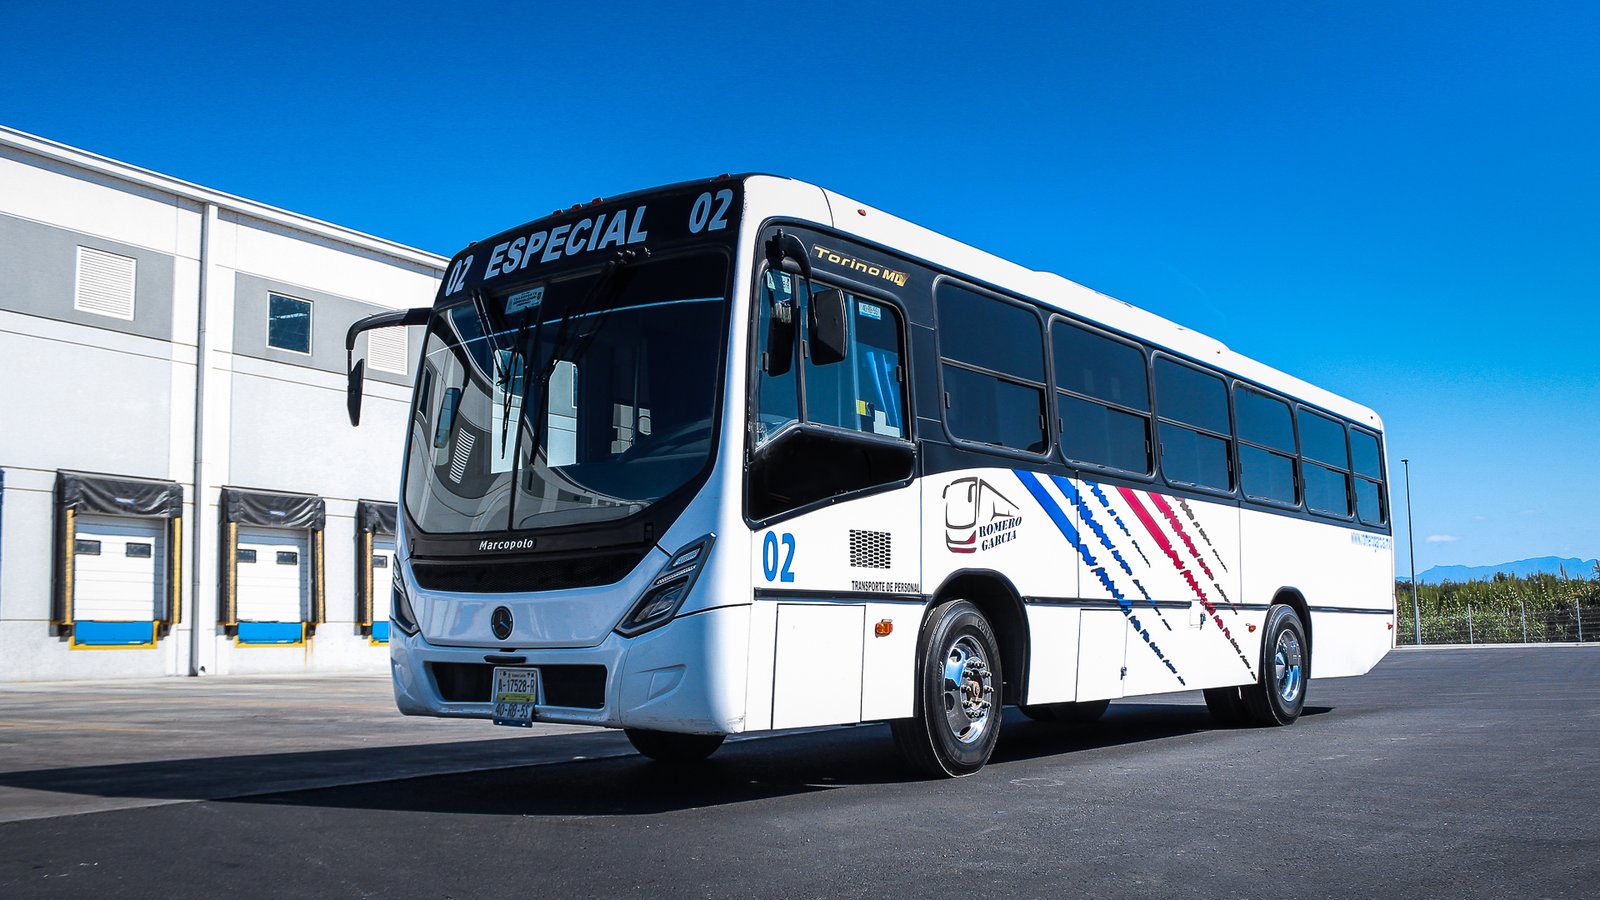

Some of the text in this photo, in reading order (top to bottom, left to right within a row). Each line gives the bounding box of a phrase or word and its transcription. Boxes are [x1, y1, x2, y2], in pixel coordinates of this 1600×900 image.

[445, 188, 733, 297] 02 ESPECIAL 02
[814, 246, 880, 276] Torino
[979, 516, 1022, 537] ROMERO
[478, 538, 533, 550] Marcopolo
[981, 530, 1017, 551] GARCIA
[762, 531, 796, 582] 02
[851, 580, 920, 593] TRANSPORTE DE PERSONAL
